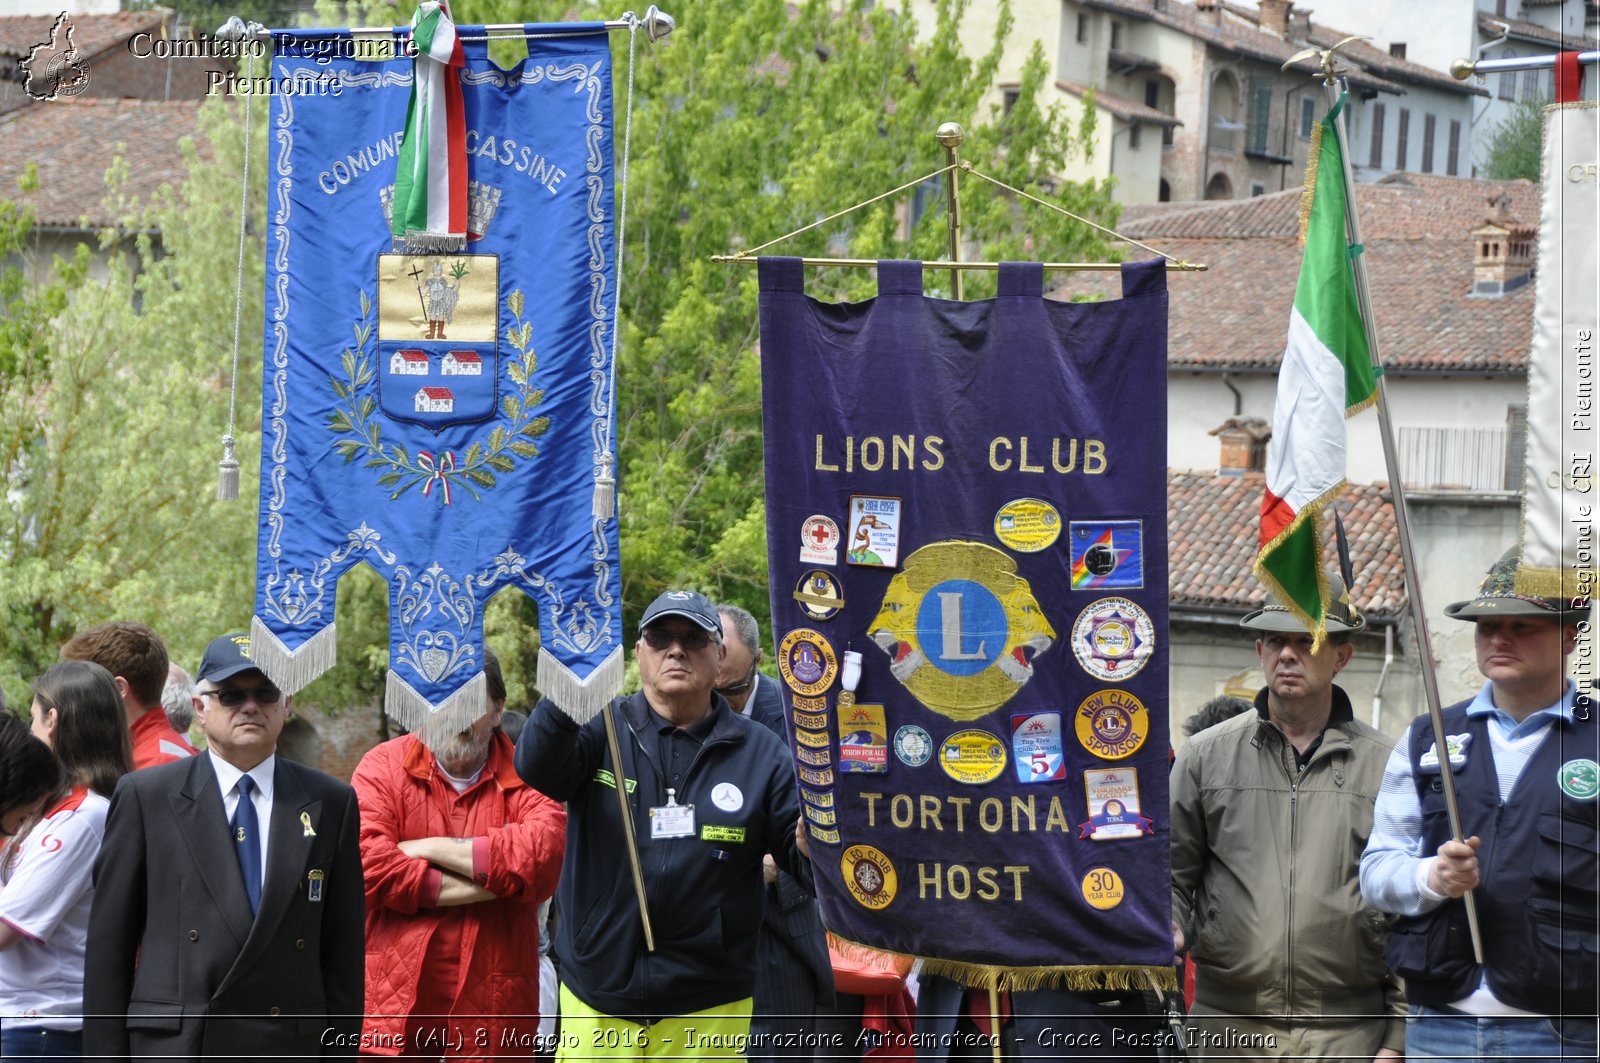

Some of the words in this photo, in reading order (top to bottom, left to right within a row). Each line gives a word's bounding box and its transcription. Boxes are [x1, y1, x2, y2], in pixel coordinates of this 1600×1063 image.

[465, 130, 567, 195] CASSINE
[815, 434, 945, 473] LIONS
[988, 436, 1108, 475] CLUB
[794, 630, 816, 640] LCIF
[937, 591, 988, 662] L
[780, 648, 791, 679] MELVIN
[789, 677, 811, 694] JONES
[813, 651, 836, 693] FELLOWSHIP
[1081, 696, 1104, 719] NEW
[1109, 692, 1140, 715] CLUB
[842, 749, 861, 757] VISION
[1085, 731, 1142, 756] SPONSOR
[1031, 753, 1049, 775] 5
[859, 791, 1071, 834] TORTONA
[846, 848, 864, 866] LEO
[867, 849, 891, 875] CLUB
[849, 880, 891, 907] SPONSOR
[918, 863, 1031, 902] HOST
[1090, 871, 1115, 892] 30
[1105, 891, 1121, 899] CLUB
